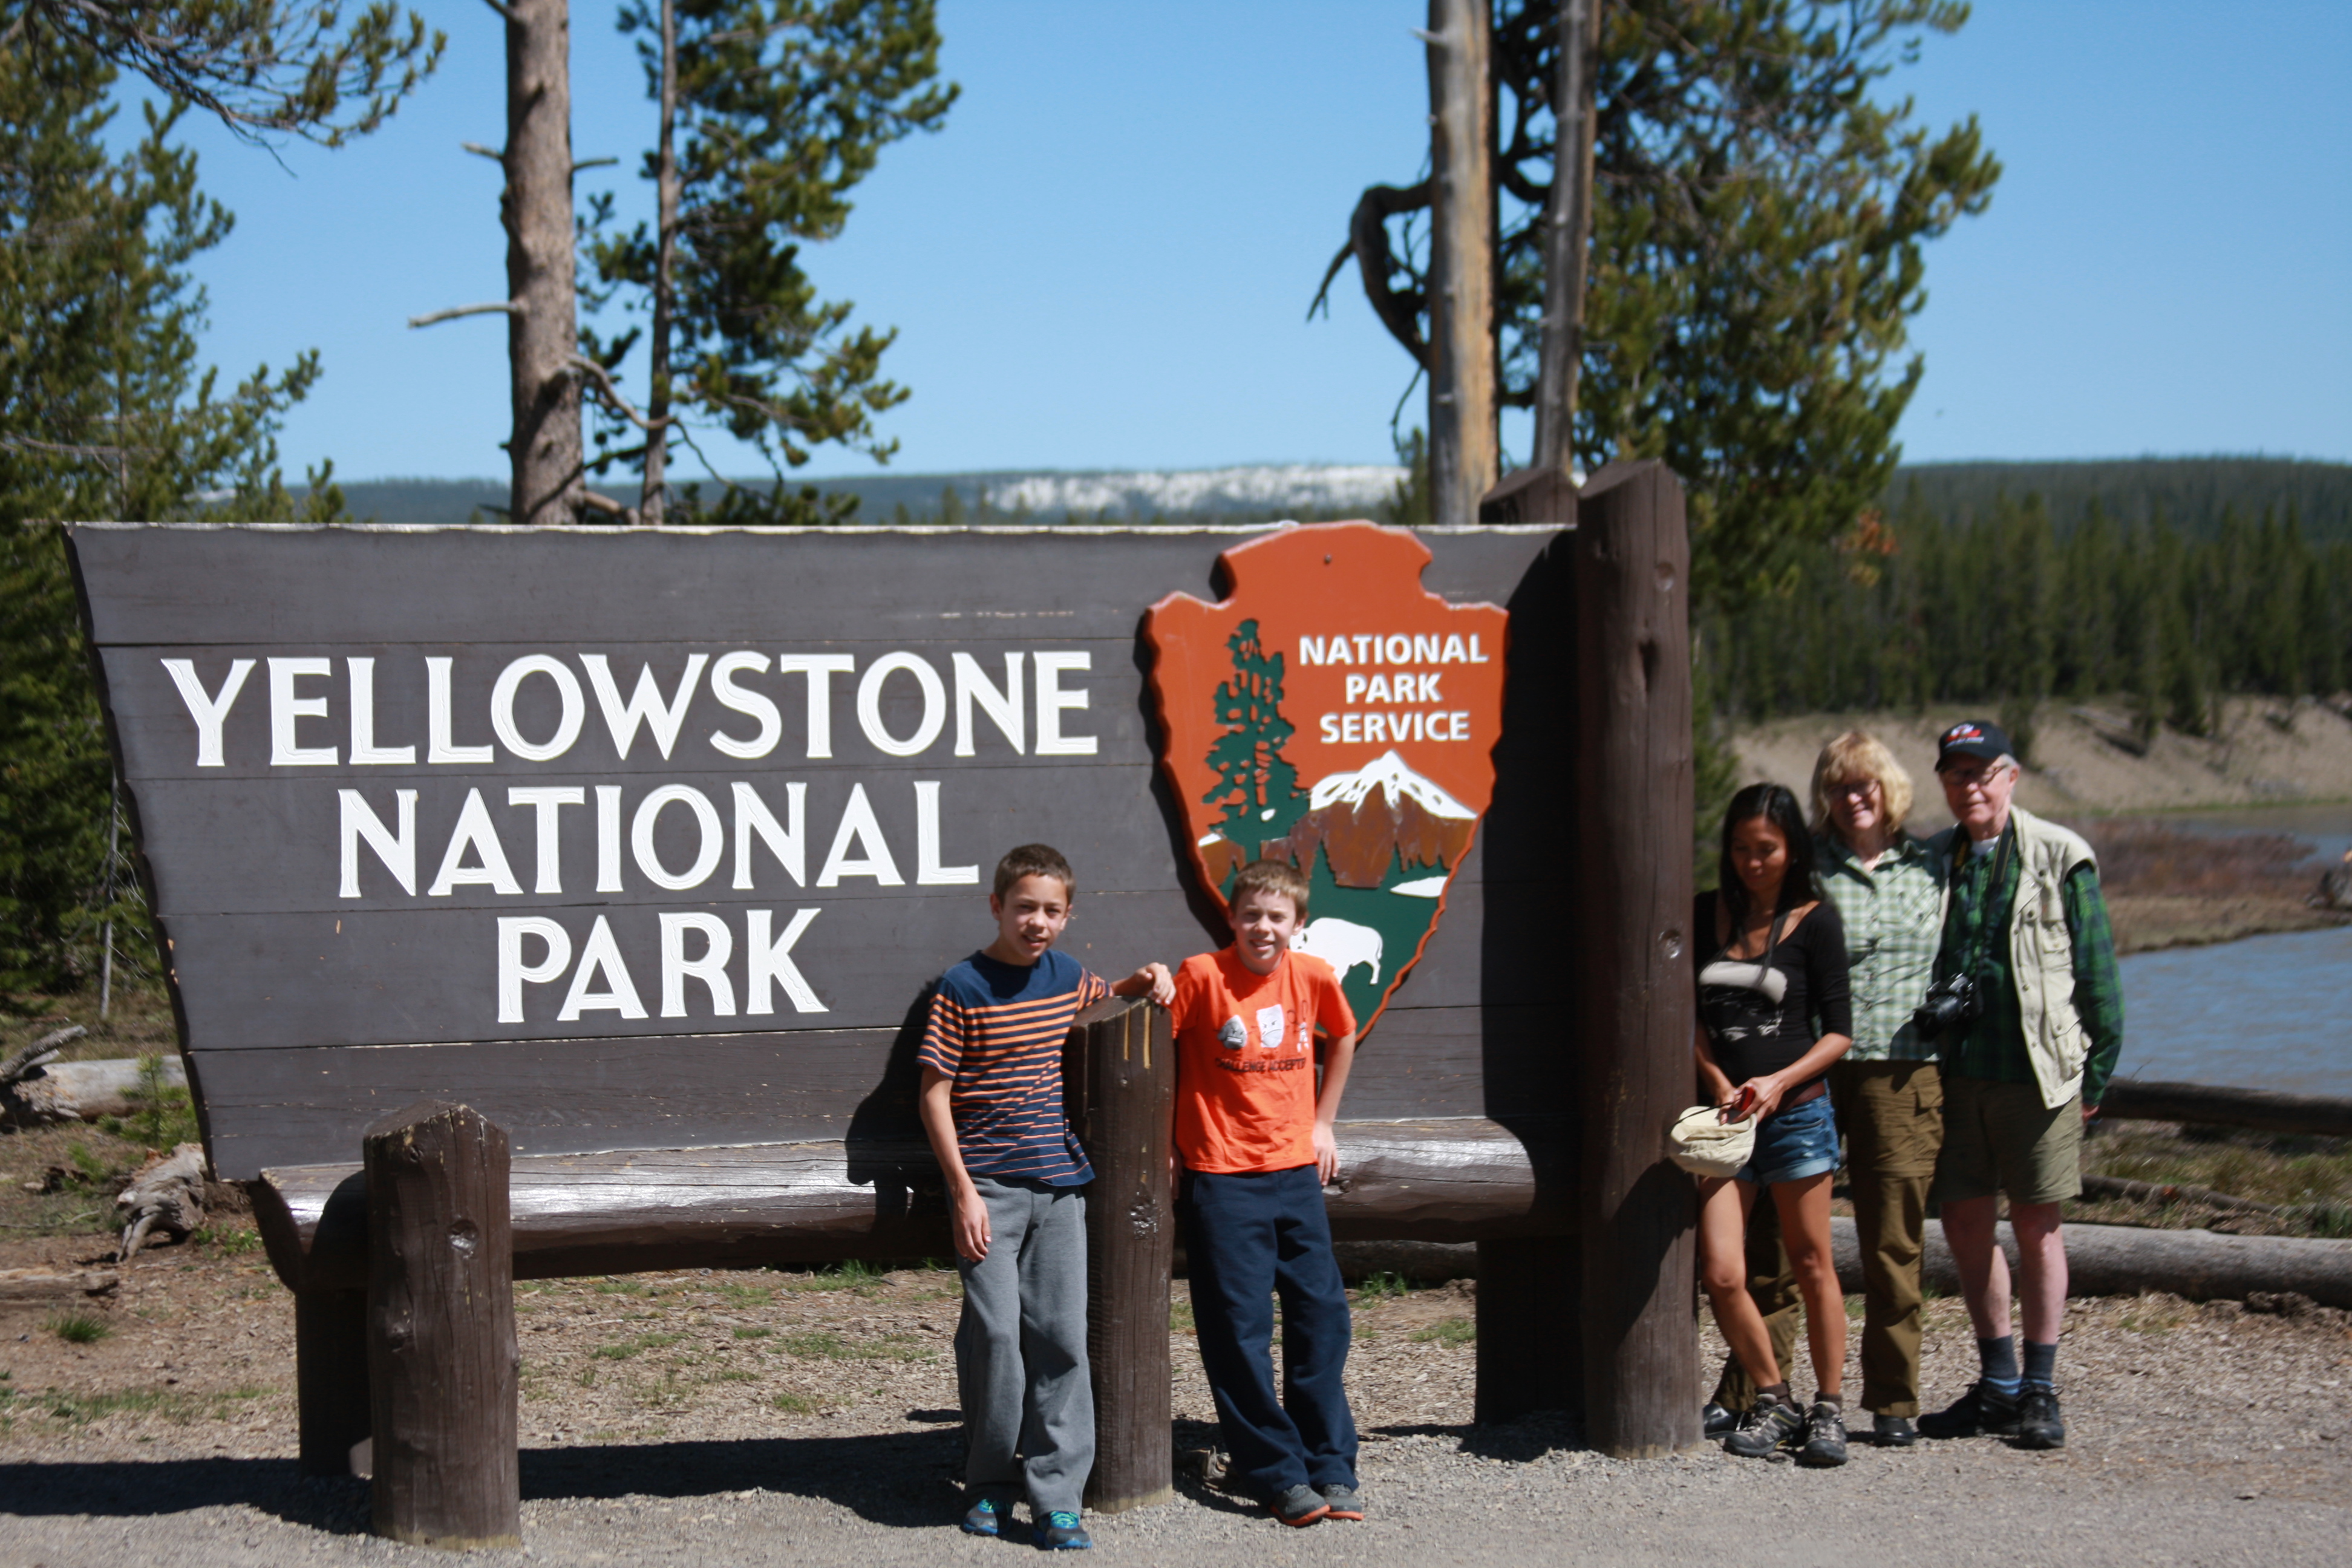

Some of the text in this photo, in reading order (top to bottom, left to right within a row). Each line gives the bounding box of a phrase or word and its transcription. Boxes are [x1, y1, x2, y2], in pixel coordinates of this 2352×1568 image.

[1299, 633, 1488, 665] NATIONAL
[160, 650, 1099, 767] YELLOWSTONE
[1345, 673, 1442, 704] PARK
[1320, 711, 1469, 743] SERVICE
[338, 780, 980, 898] NATIONAL
[497, 907, 830, 1024] PARK
